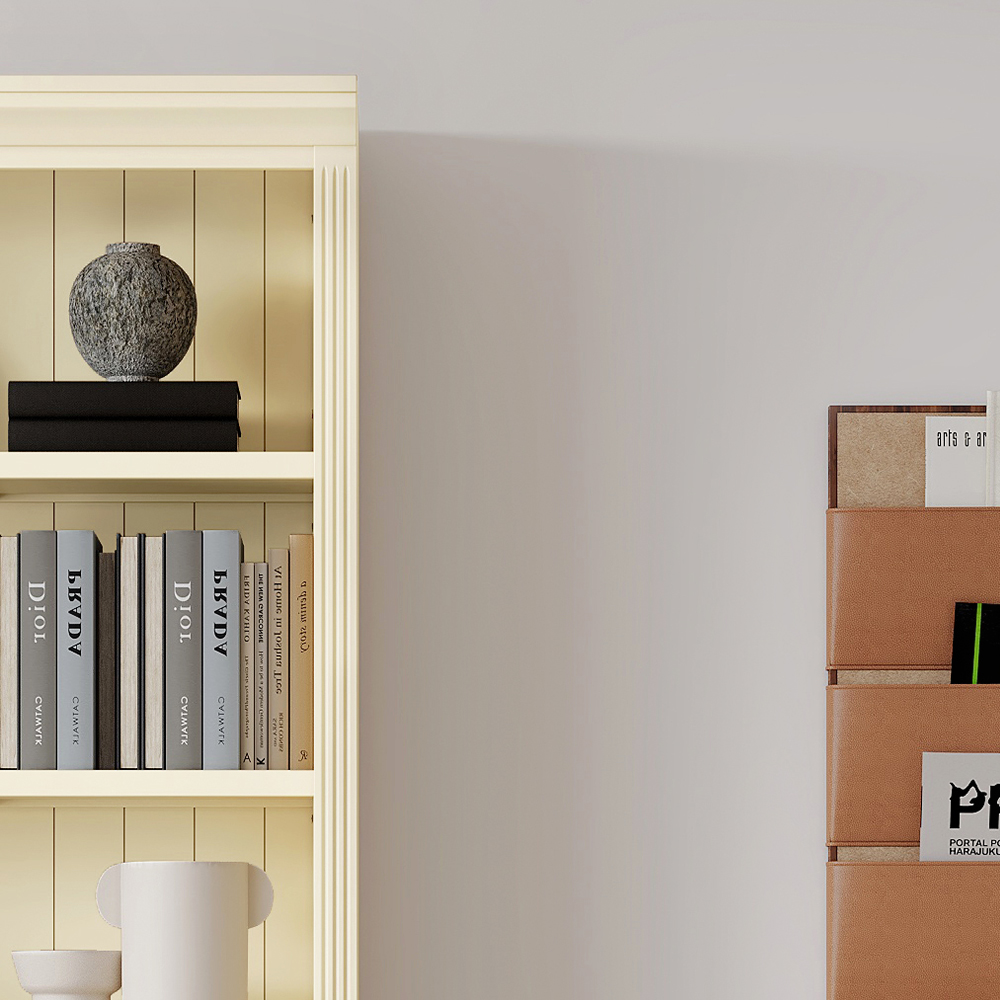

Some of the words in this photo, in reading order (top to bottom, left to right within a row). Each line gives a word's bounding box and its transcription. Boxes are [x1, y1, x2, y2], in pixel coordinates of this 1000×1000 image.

[936, 428, 958, 447] arts
[964, 431, 972, 448] &
[949, 838, 988, 847] PORTAL
